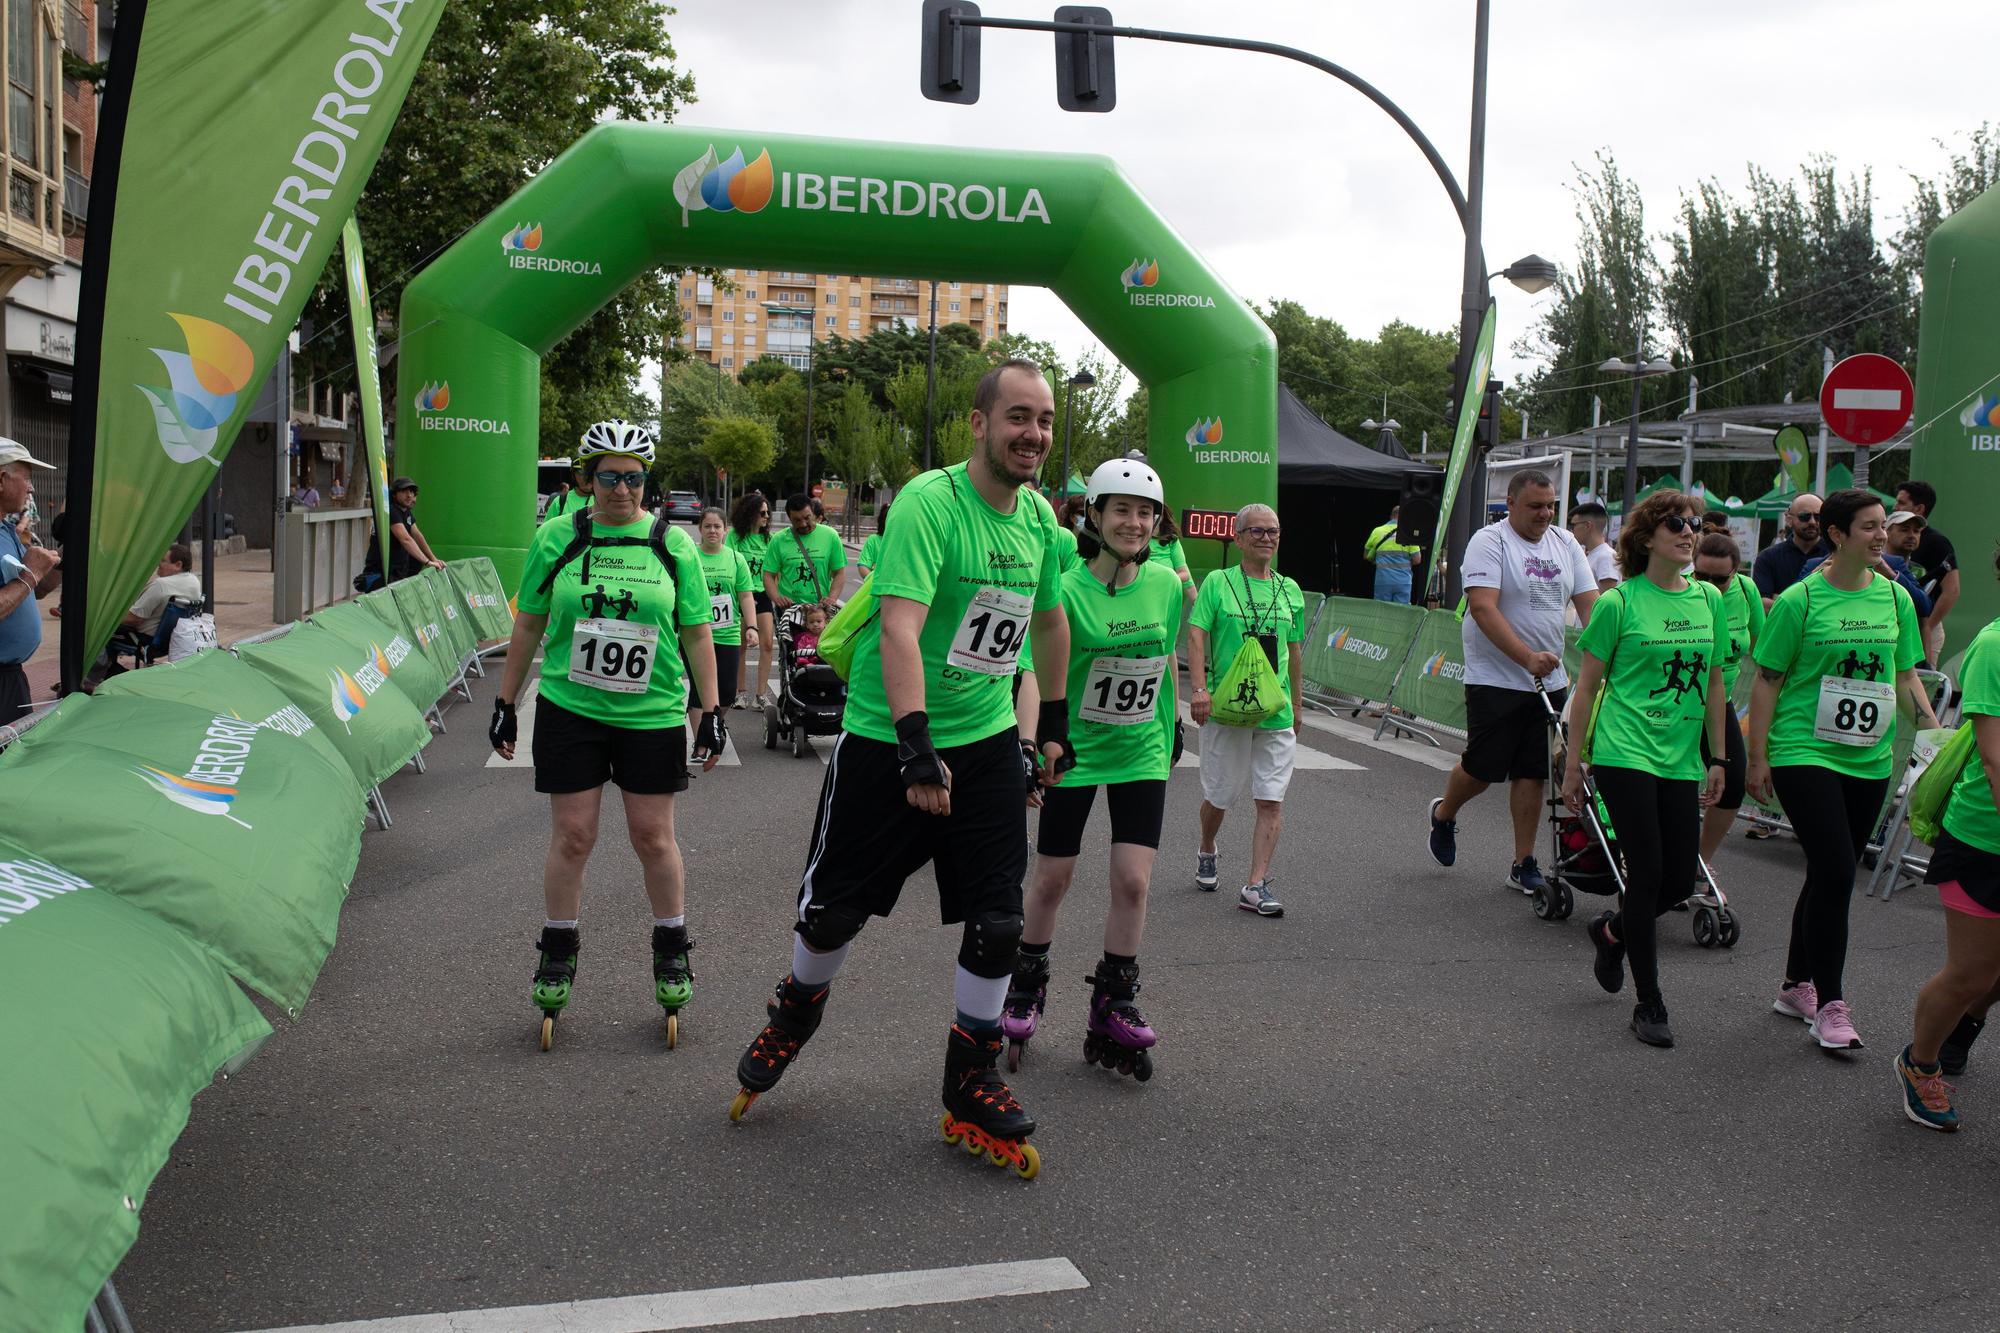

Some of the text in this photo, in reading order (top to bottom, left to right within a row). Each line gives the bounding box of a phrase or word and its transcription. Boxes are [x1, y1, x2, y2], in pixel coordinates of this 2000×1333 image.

[223, 0, 414, 325] IBERDROLA
[781, 171, 1052, 225] IBERDROLA
[509, 254, 602, 275] IBERDROLA
[1129, 293, 1216, 308] IBERDROLA
[420, 416, 511, 435] IBERDROLA
[1195, 450, 1271, 465] IBERDROLA
[625, 577, 661, 585] IGUALDAD
[1008, 580, 1019, 588] LA
[711, 603, 730, 623] 01
[968, 611, 1030, 659] 194
[1111, 626, 1141, 638] UNIVERSO
[1667, 625, 1693, 633] UNIVERSO
[1090, 645, 1116, 653] FORMA
[1342, 636, 1389, 662] IBERDROLA
[1824, 638, 1849, 646] FORMA
[1850, 637, 1864, 645] POR
[580, 638, 649, 679] 196
[1093, 676, 1158, 712] 195
[1834, 697, 1879, 734] 89
